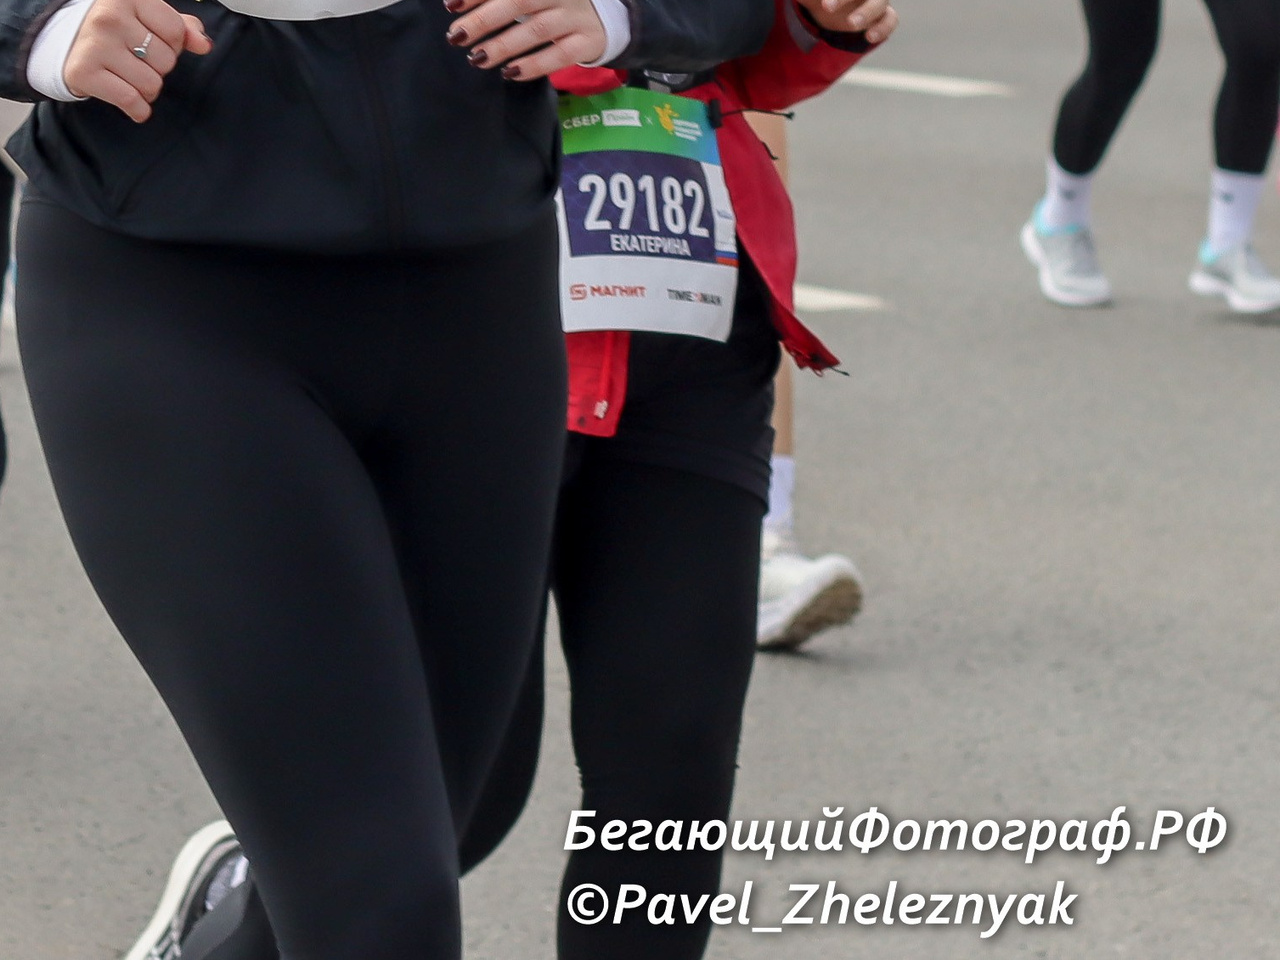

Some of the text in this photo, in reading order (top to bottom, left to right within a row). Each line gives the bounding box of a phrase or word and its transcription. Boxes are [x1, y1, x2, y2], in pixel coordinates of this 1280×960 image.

[562, 114, 601, 131] СБЕР
[578, 172, 710, 238] 29182
[609, 233, 692, 257] ЕКАТЕРИНА
[589, 284, 647, 298] МАГНИТ
